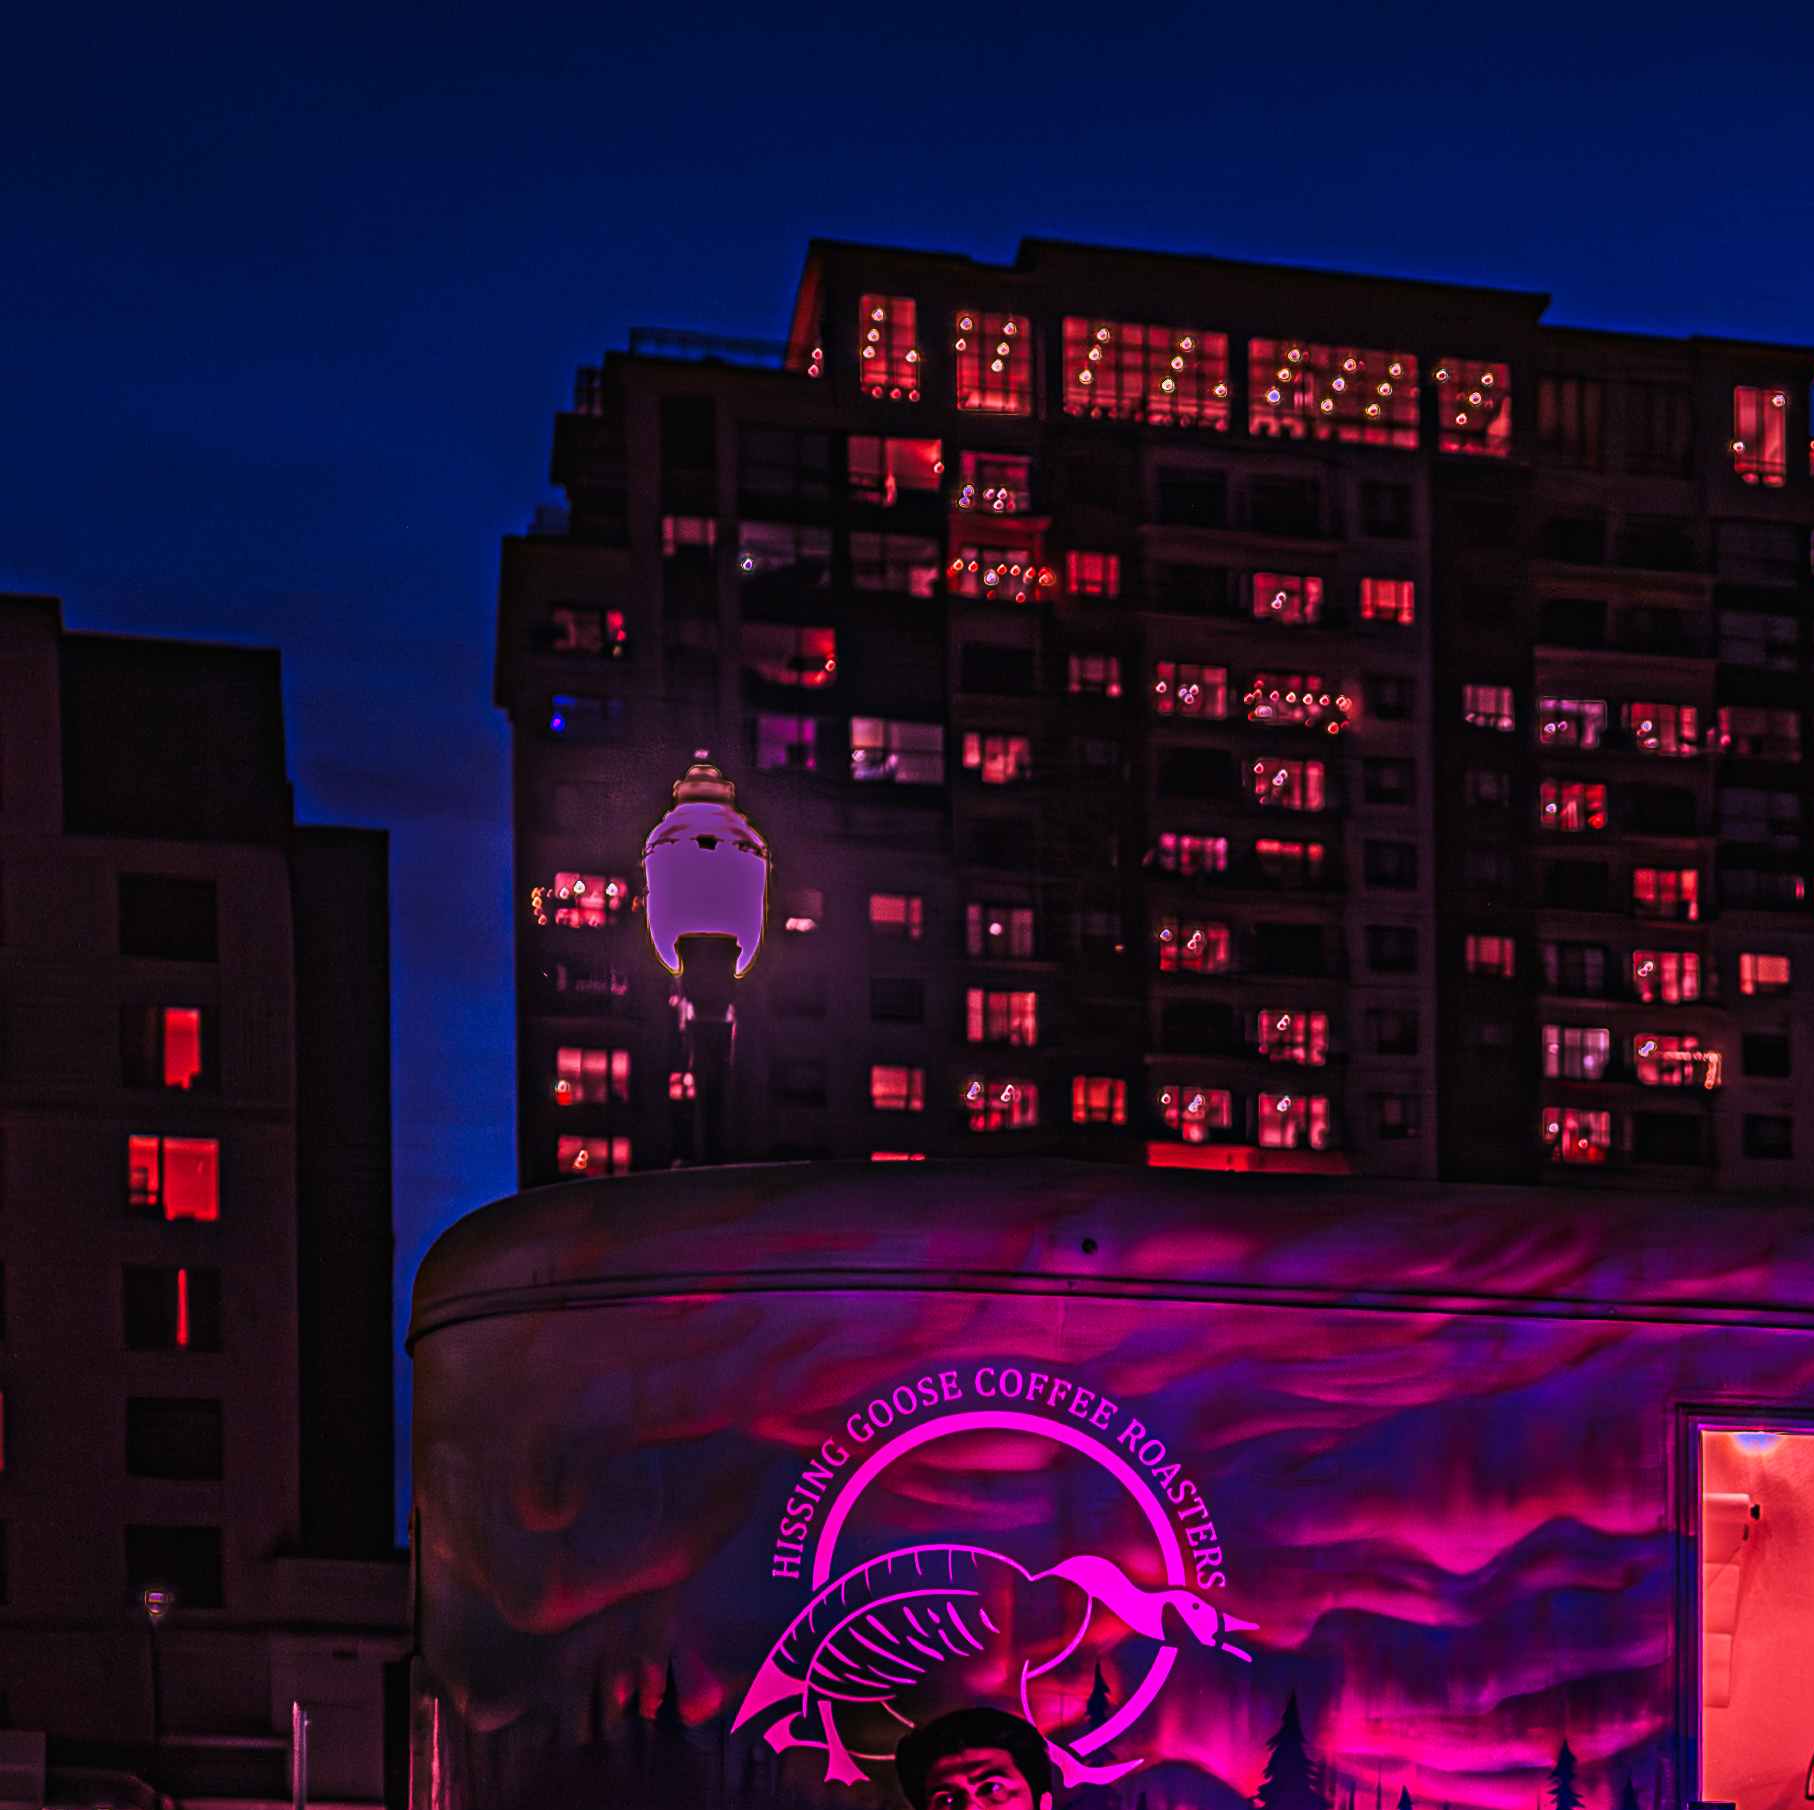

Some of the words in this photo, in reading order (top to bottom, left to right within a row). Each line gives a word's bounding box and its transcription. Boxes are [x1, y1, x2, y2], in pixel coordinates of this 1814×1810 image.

[772, 1438, 851, 1580] HISSING
[846, 1370, 963, 1446] GOOSE
[974, 1366, 1120, 1432] COFFEE
[1116, 1416, 1229, 1591] ROASTERS
